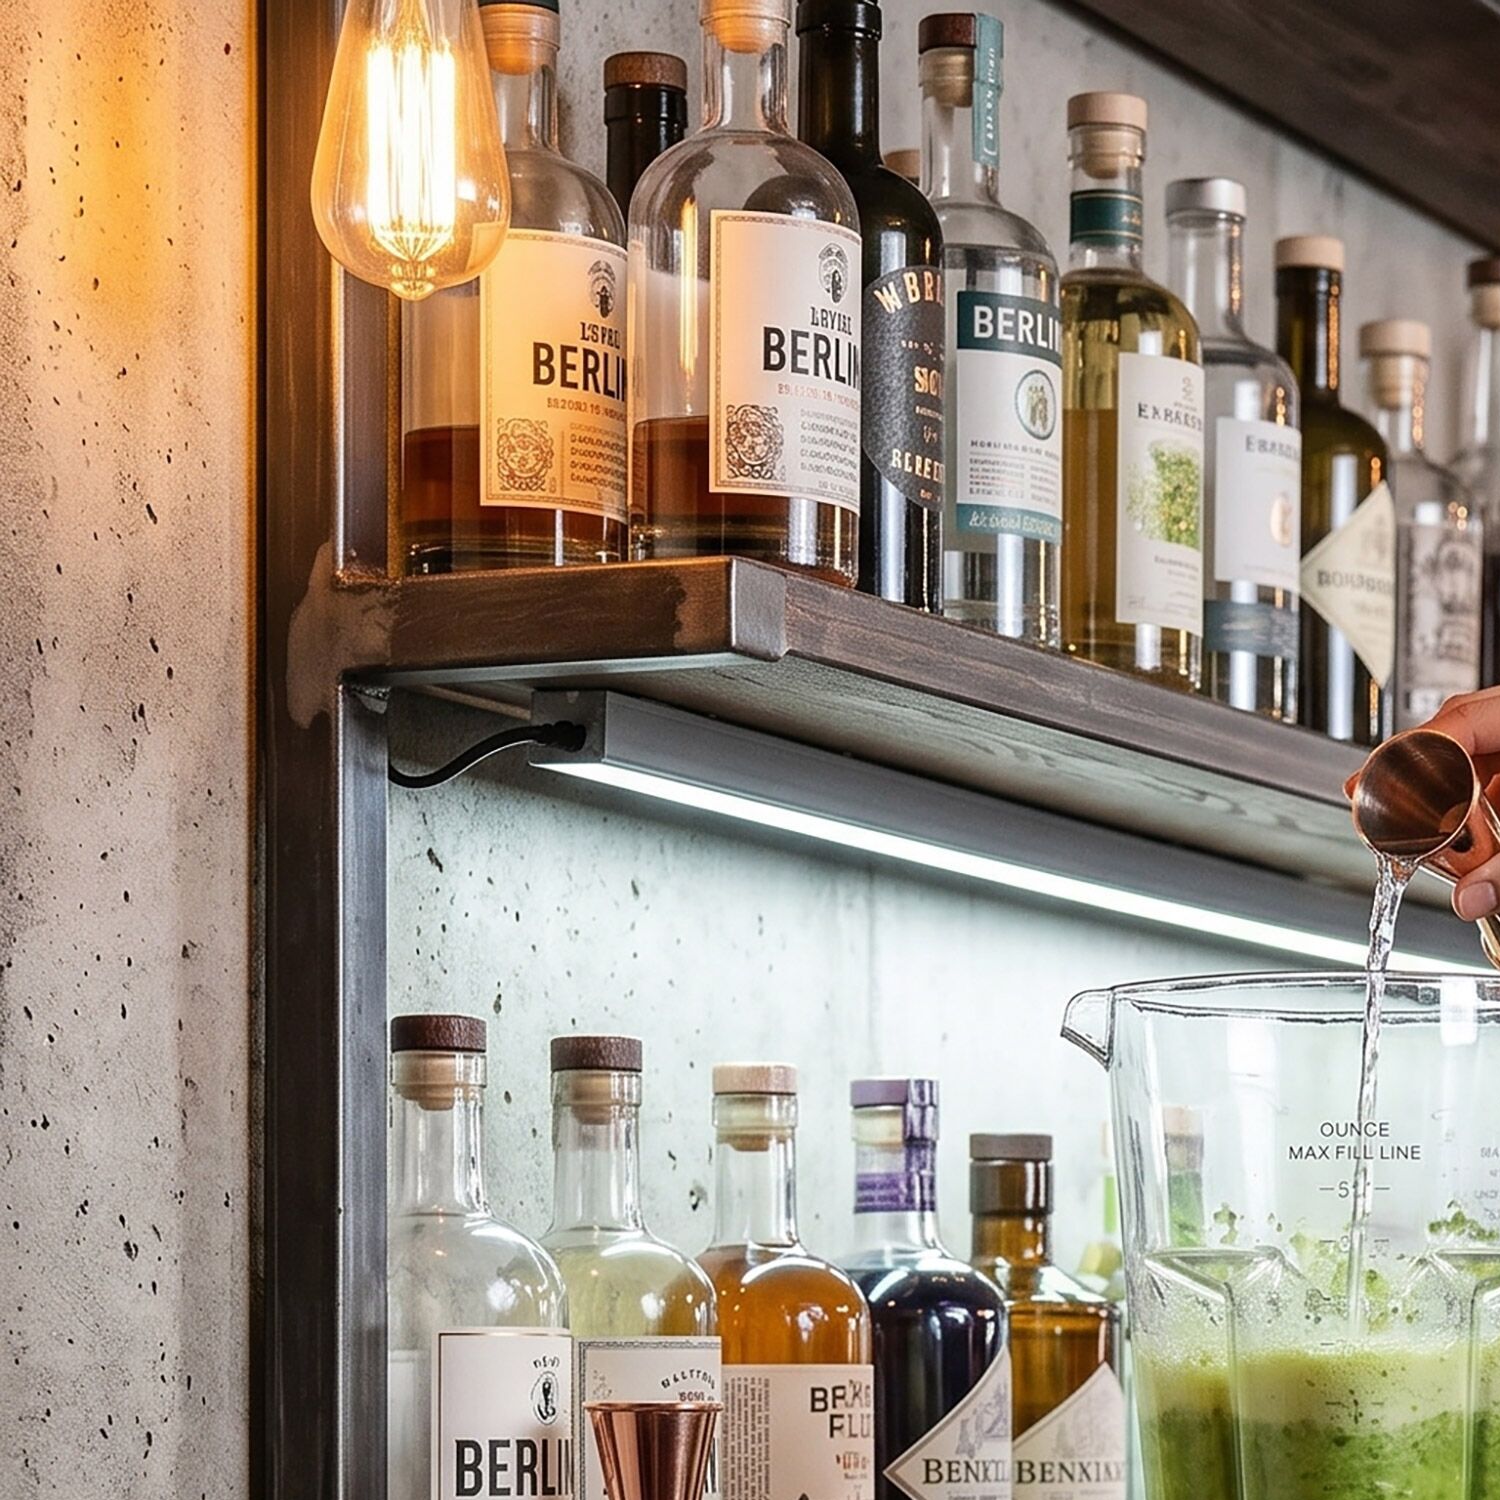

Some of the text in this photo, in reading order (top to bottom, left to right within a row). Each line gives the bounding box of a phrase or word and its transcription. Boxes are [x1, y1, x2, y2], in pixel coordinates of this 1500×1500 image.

[1320, 1121, 1390, 1137] OUNCE
[1289, 1145, 1421, 1160] MAX FILL LINE
